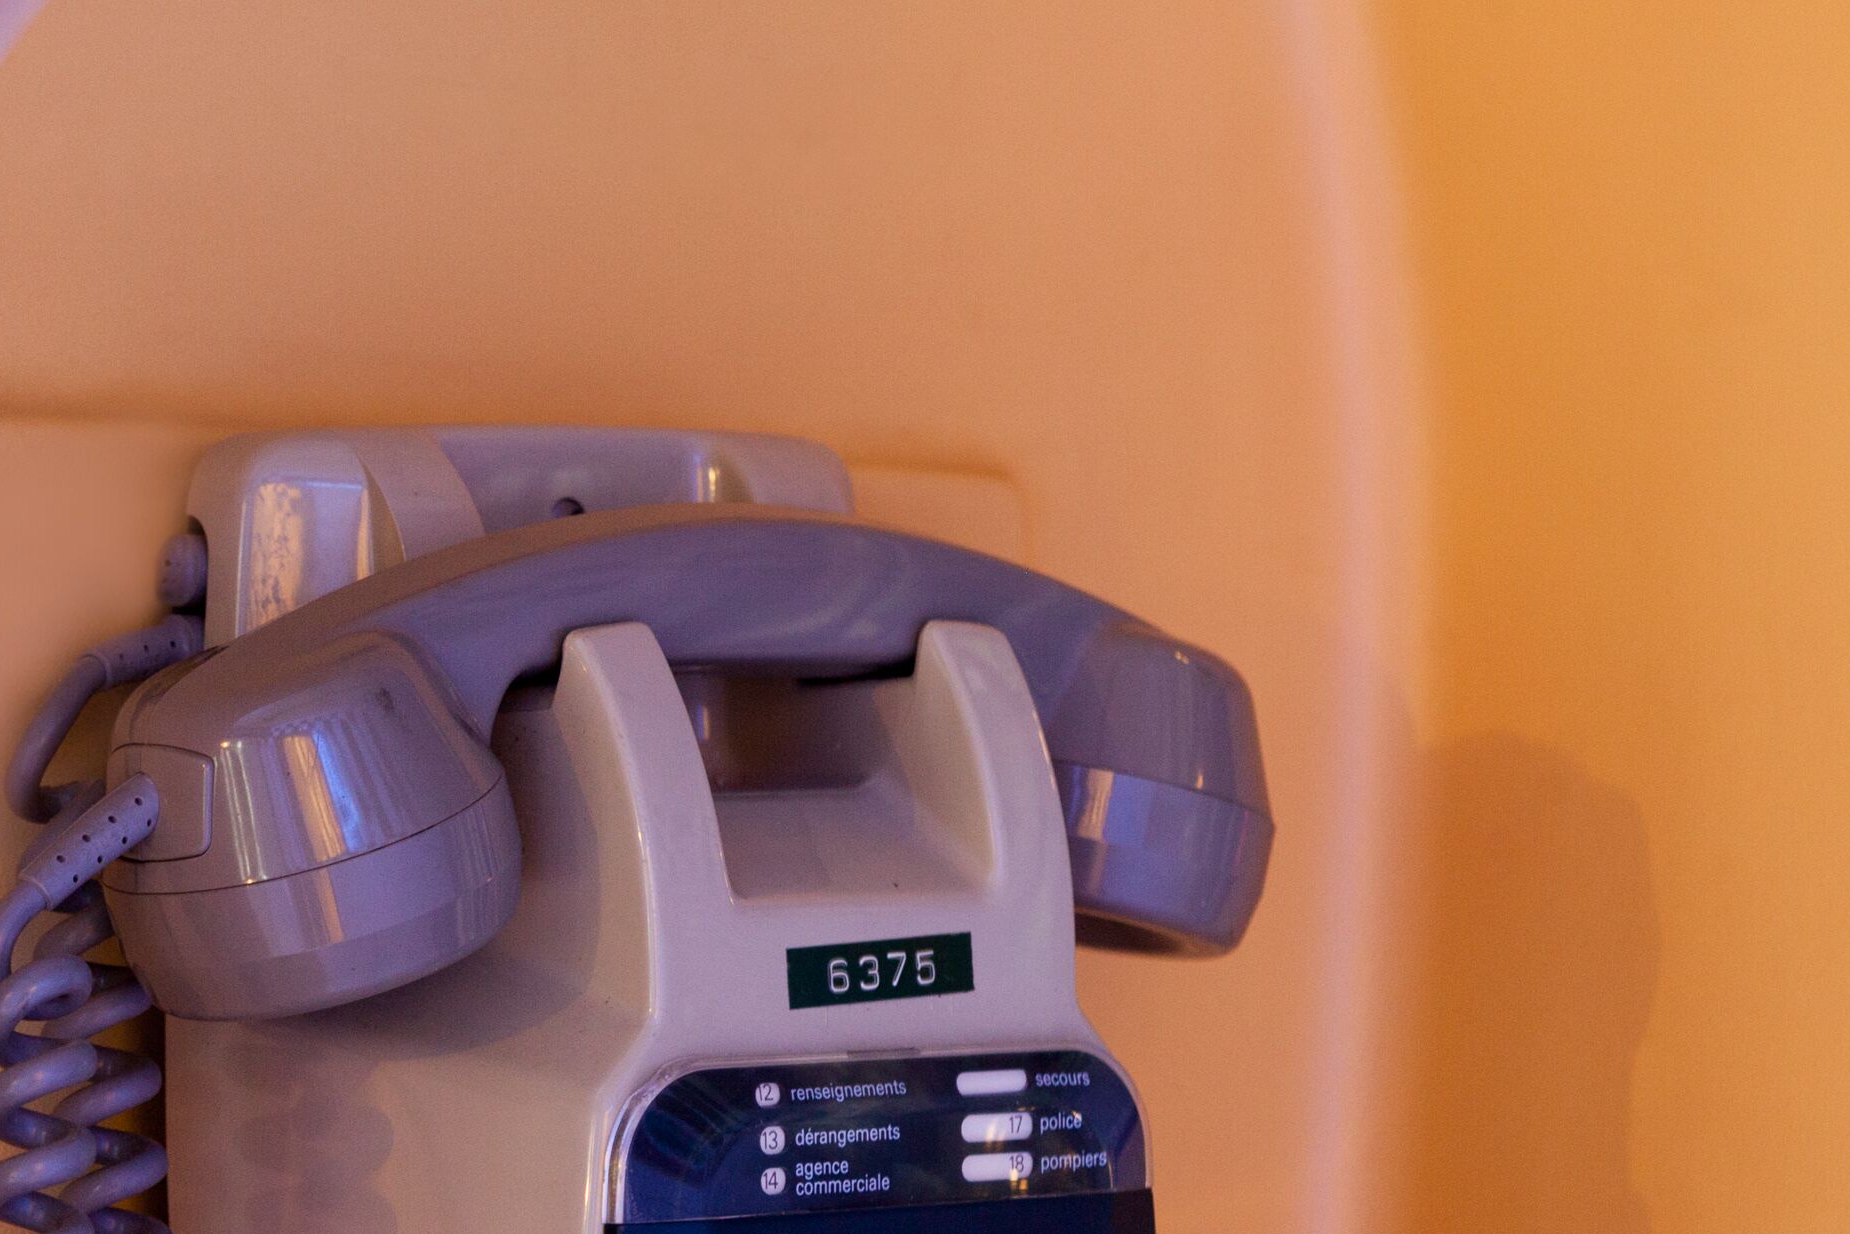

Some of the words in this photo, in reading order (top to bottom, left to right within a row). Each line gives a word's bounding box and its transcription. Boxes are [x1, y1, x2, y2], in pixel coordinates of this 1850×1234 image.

[828, 949, 937, 994] 6375
[757, 1083, 774, 1102] 12
[791, 1080, 907, 1102] renseignements
[1035, 1071, 1091, 1087] secours
[1008, 1115, 1024, 1134] 17
[1040, 1111, 1083, 1135] police
[761, 1130, 779, 1150] 13
[795, 1124, 901, 1148] dérangements
[1009, 1154, 1025, 1173] 18
[1040, 1150, 1108, 1174] pompiers
[762, 1171, 779, 1190] 14
[795, 1160, 849, 1180] agence
[795, 1173, 891, 1196] commerciale
